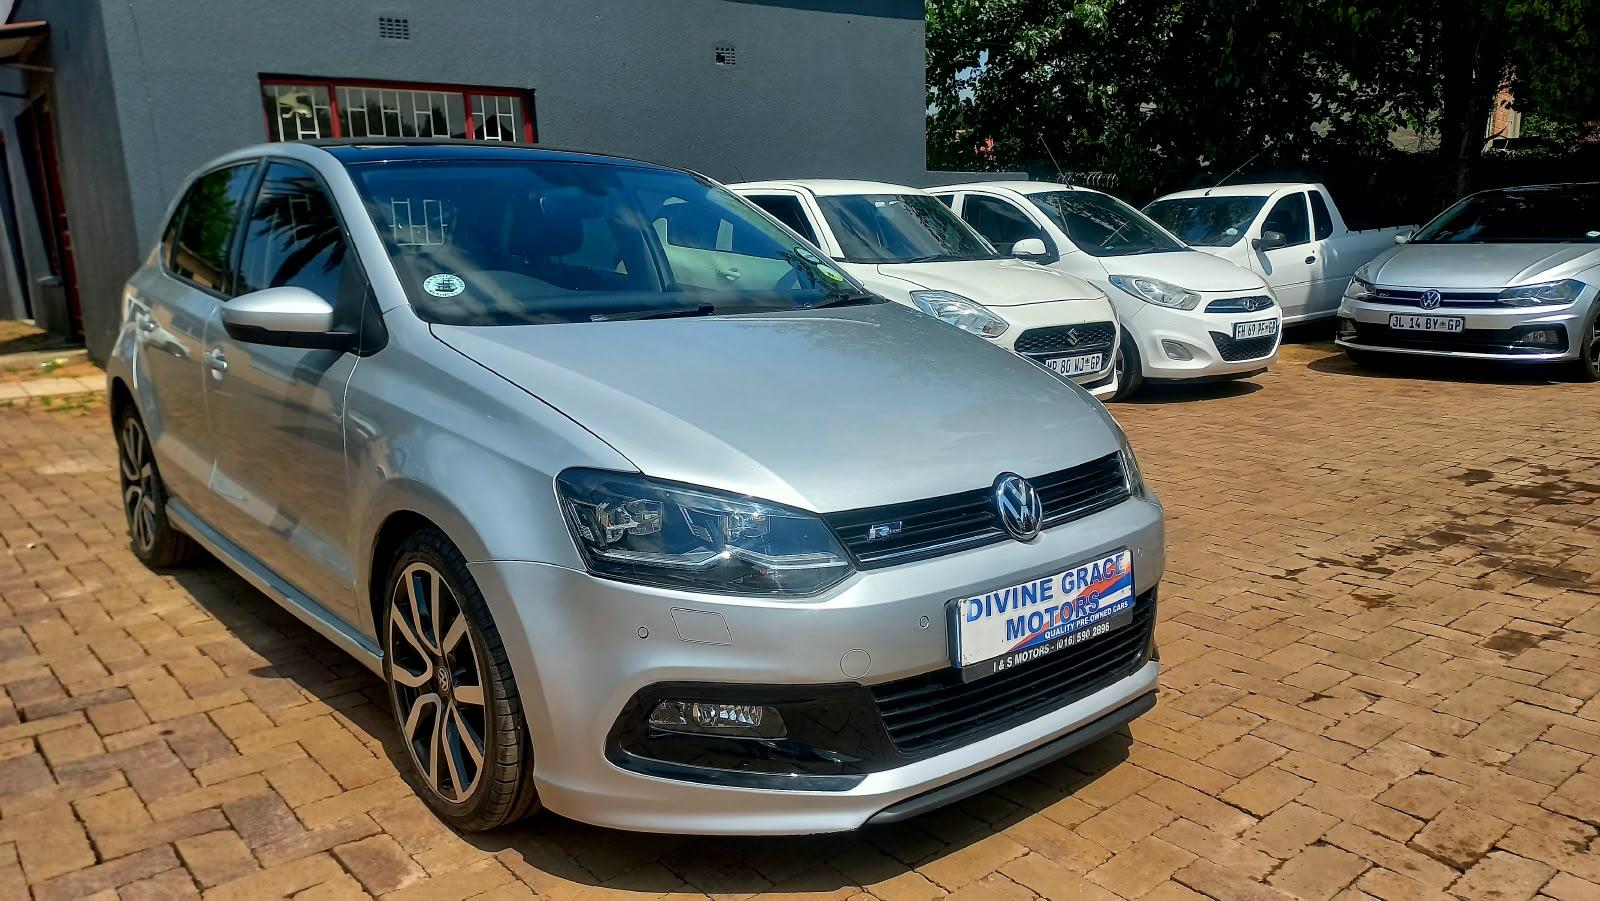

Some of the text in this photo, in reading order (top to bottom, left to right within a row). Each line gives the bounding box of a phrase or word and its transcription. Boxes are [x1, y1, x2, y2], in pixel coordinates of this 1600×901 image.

[1392, 316, 1461, 331] JL 14 BY GP
[1060, 359, 1071, 374] 80
[1090, 355, 1101, 370] GP
[966, 553, 1125, 623] DIVINE GRACE
[1006, 591, 1100, 641] MOTORS
[1046, 600, 1129, 640] QUALITY PRE-OWNED CARS
[998, 659, 1005, 671] &
[1006, 656, 1013, 668] S
[1014, 643, 1050, 664] MOTORS
[1056, 634, 1075, 650] (016)
[1076, 630, 1091, 644] 590
